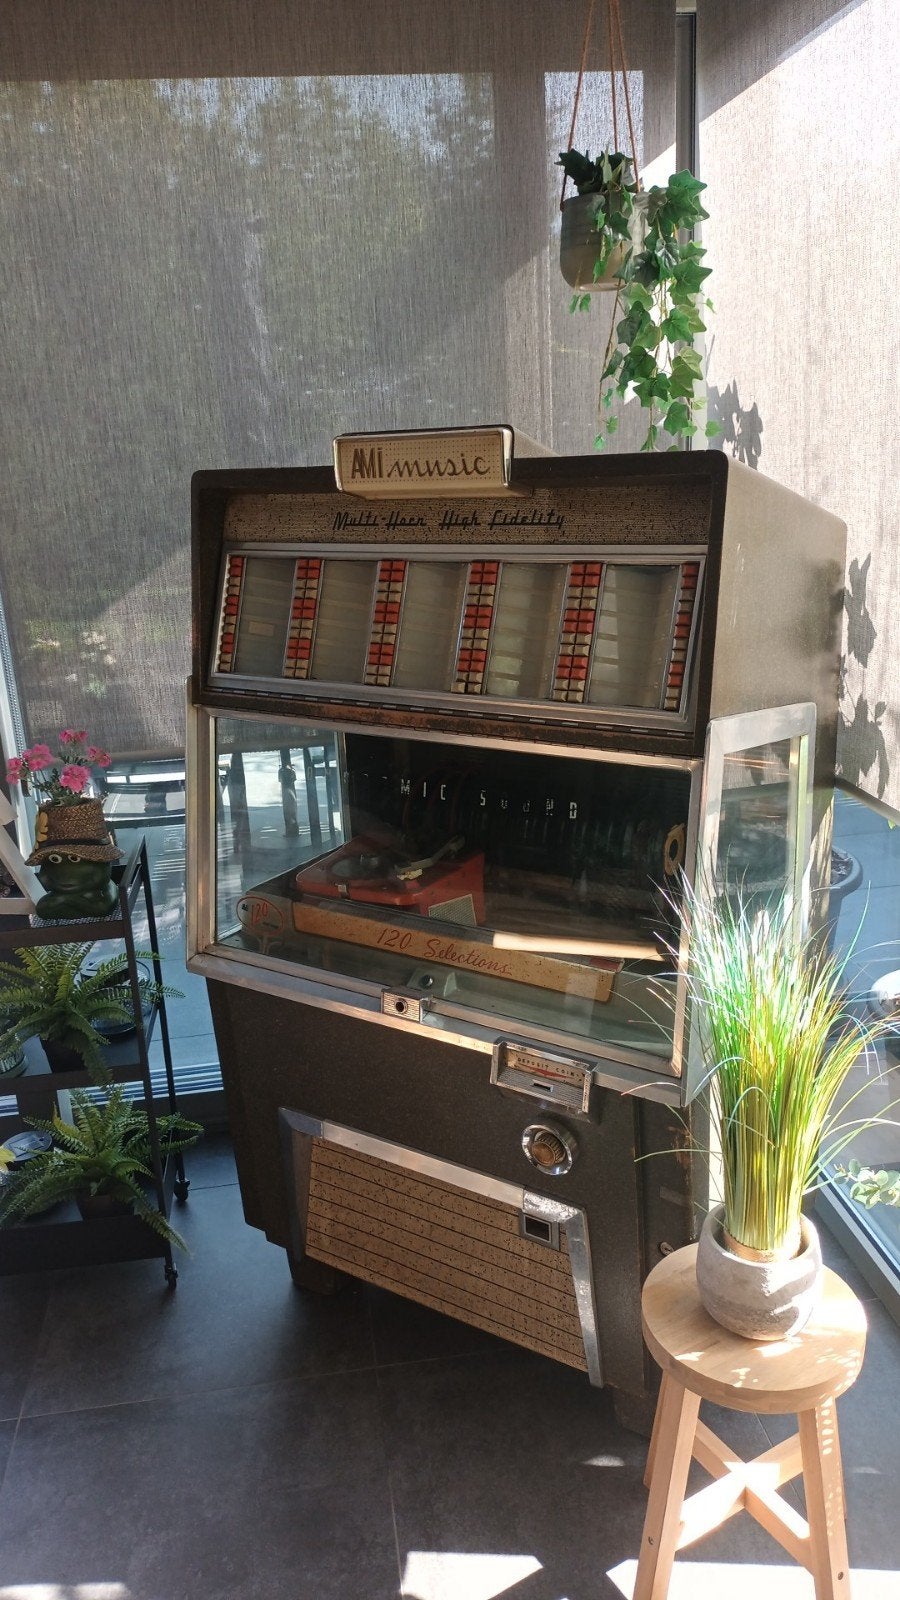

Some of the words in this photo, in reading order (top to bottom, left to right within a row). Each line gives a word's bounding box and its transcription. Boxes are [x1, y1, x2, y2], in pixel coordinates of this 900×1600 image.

[387, 453, 490, 478] music
[439, 510, 481, 531] High
[488, 509, 565, 530] Fidelity
[376, 928, 412, 949] 120
[424, 938, 512, 975] Selections
